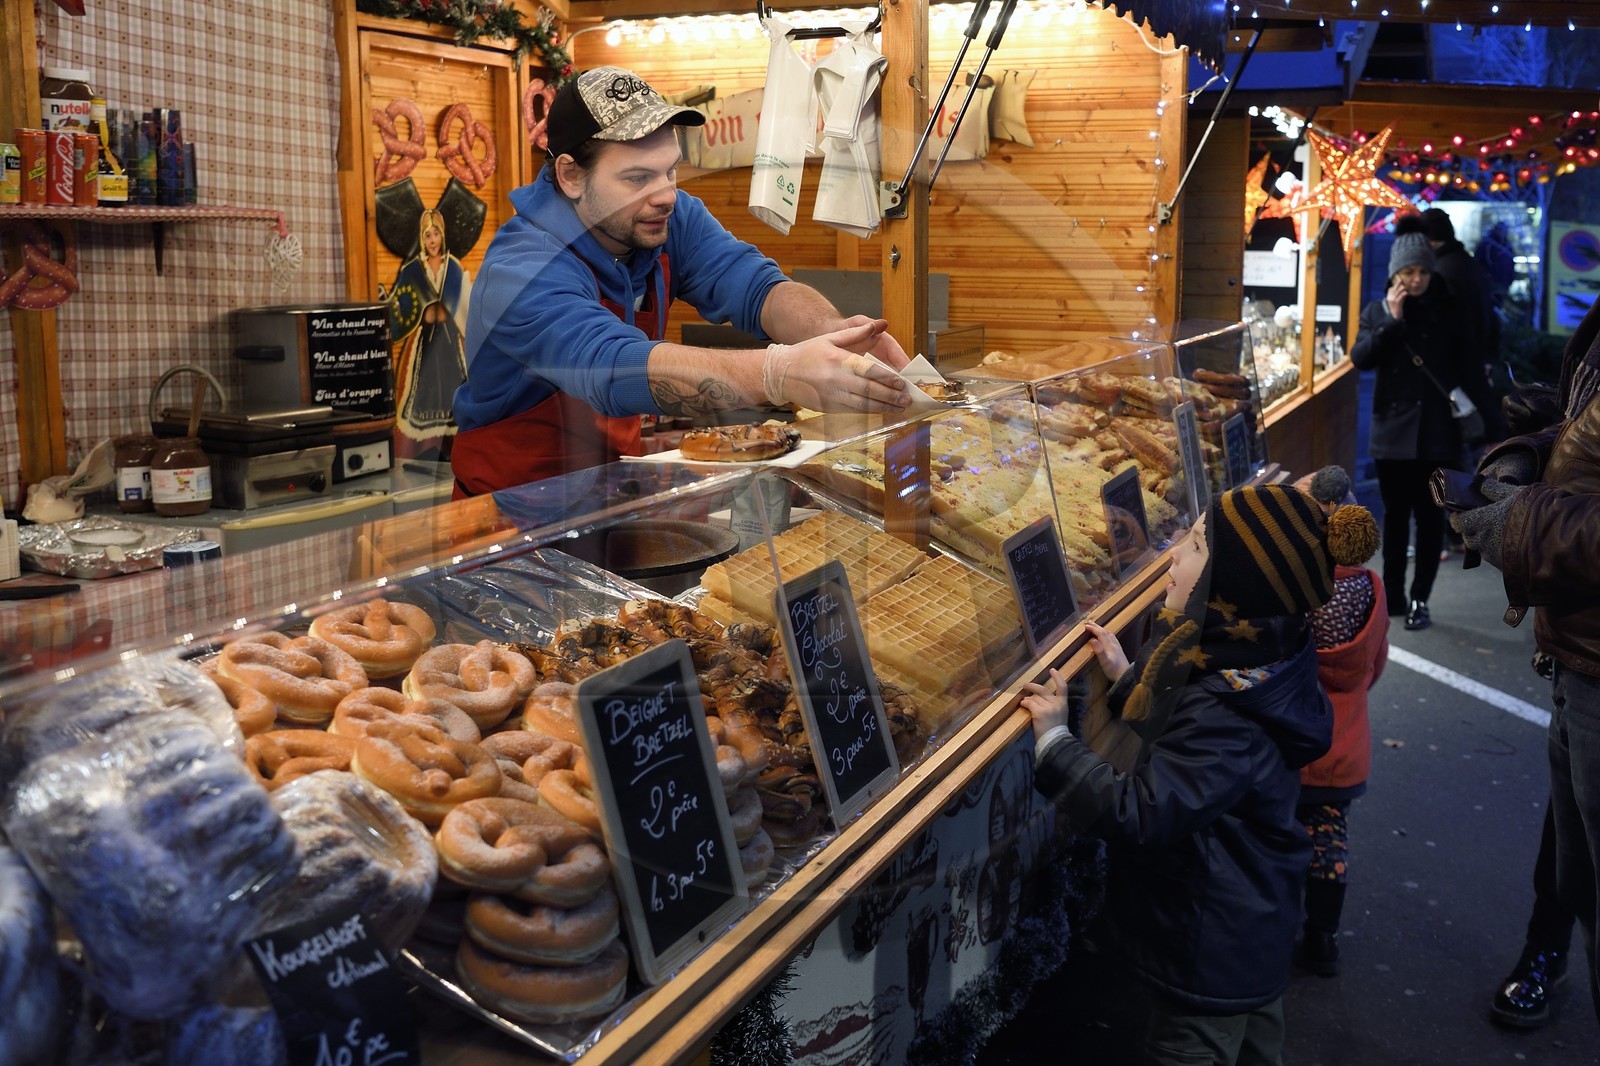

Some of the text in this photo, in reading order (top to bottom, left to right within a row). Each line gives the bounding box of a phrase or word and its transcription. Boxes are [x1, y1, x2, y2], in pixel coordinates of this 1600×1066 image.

[51, 102, 91, 115] nutell
[704, 112, 745, 148] vin
[311, 318, 333, 329] Vin
[336, 318, 366, 329] chaud
[313, 349, 387, 362] Vin chaud blanc
[339, 387, 382, 399] d'oranges
[791, 592, 839, 636] BRETZEL
[604, 680, 678, 746] BEIGNET
[632, 714, 693, 767] BRETZEL
[832, 747, 846, 776] 3
[668, 873, 680, 901] 3
